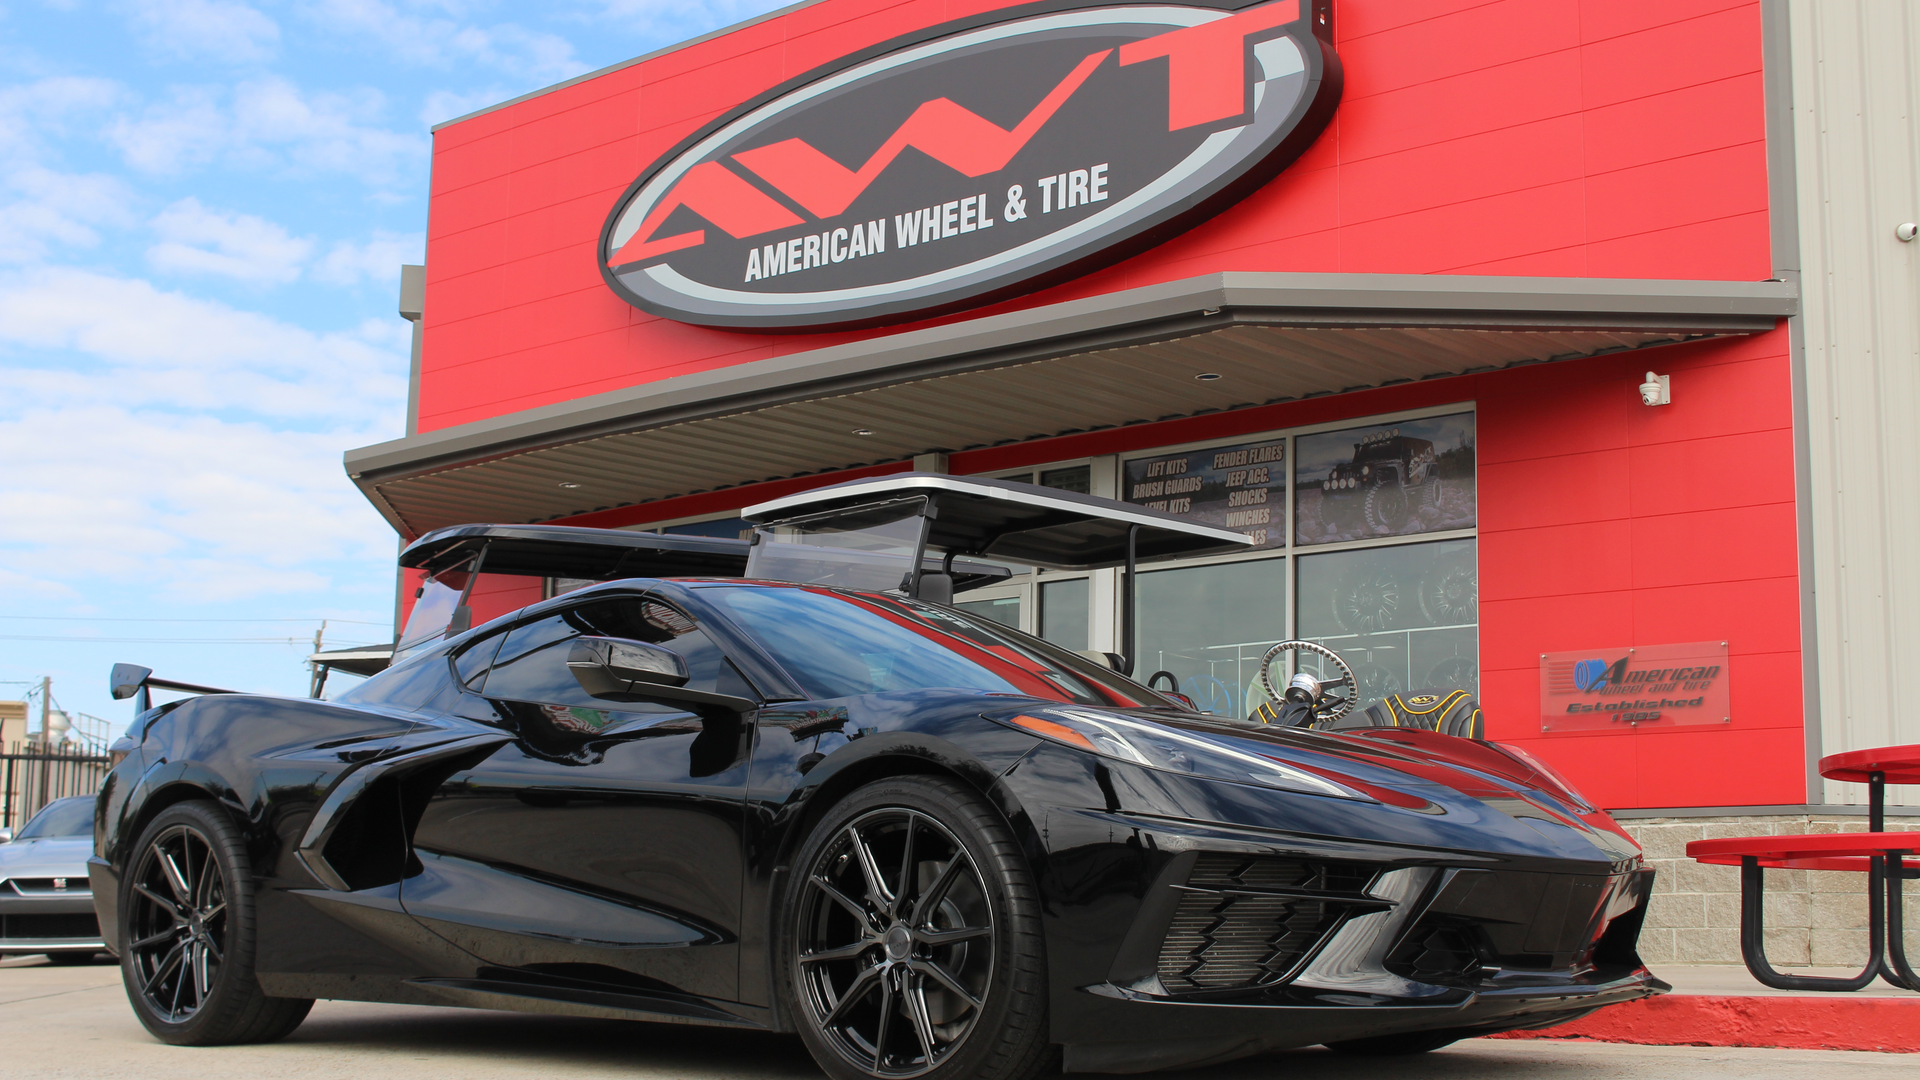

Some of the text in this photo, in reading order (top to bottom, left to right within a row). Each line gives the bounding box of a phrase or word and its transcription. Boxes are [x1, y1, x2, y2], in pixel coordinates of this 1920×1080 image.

[607, 0, 1300, 267] AWT
[744, 162, 1109, 283] AMERICAN WHEEL & TIRE
[1213, 444, 1284, 470] FENDER FLARES
[1147, 458, 1188, 478] LIFT KITS
[1225, 467, 1270, 487] JEEP ACC.
[1132, 476, 1203, 499] BRUSH GUARDS
[1228, 487, 1268, 507] SHOCKS
[1169, 497, 1190, 514] KITS
[1225, 508, 1271, 528] WINCHES
[1584, 656, 1720, 693] American
[1600, 679, 1712, 695] wheel and tire
[1566, 697, 1703, 713] Established
[1611, 711, 1661, 721] 1985
